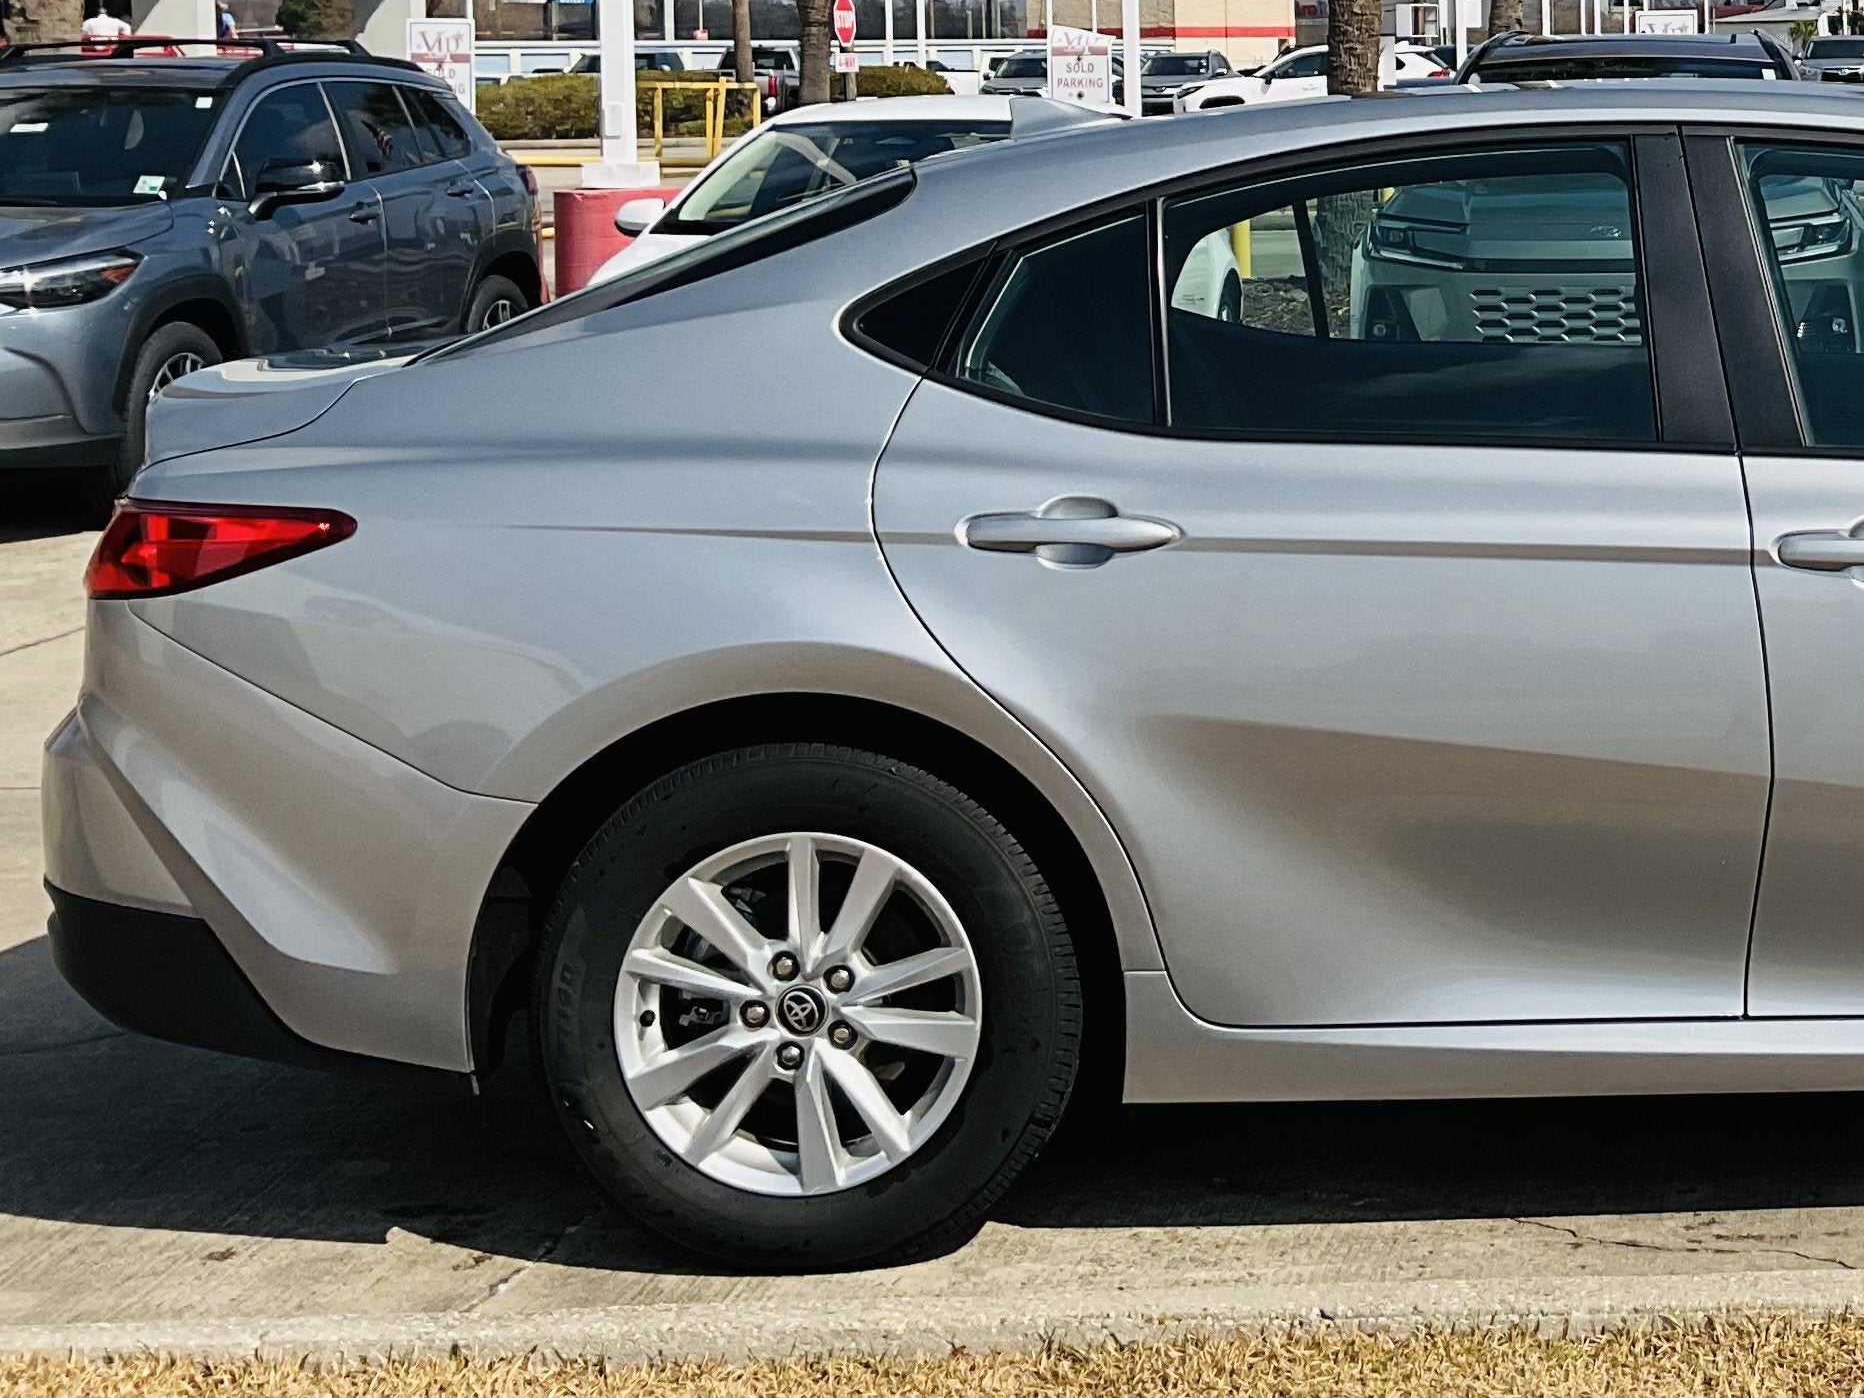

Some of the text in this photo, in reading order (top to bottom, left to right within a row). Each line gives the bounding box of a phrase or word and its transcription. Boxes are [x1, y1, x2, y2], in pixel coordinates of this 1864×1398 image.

[835, 10, 856, 29] STOP
[1066, 62, 1095, 73] SOLD
[1056, 77, 1104, 89] PARKING
